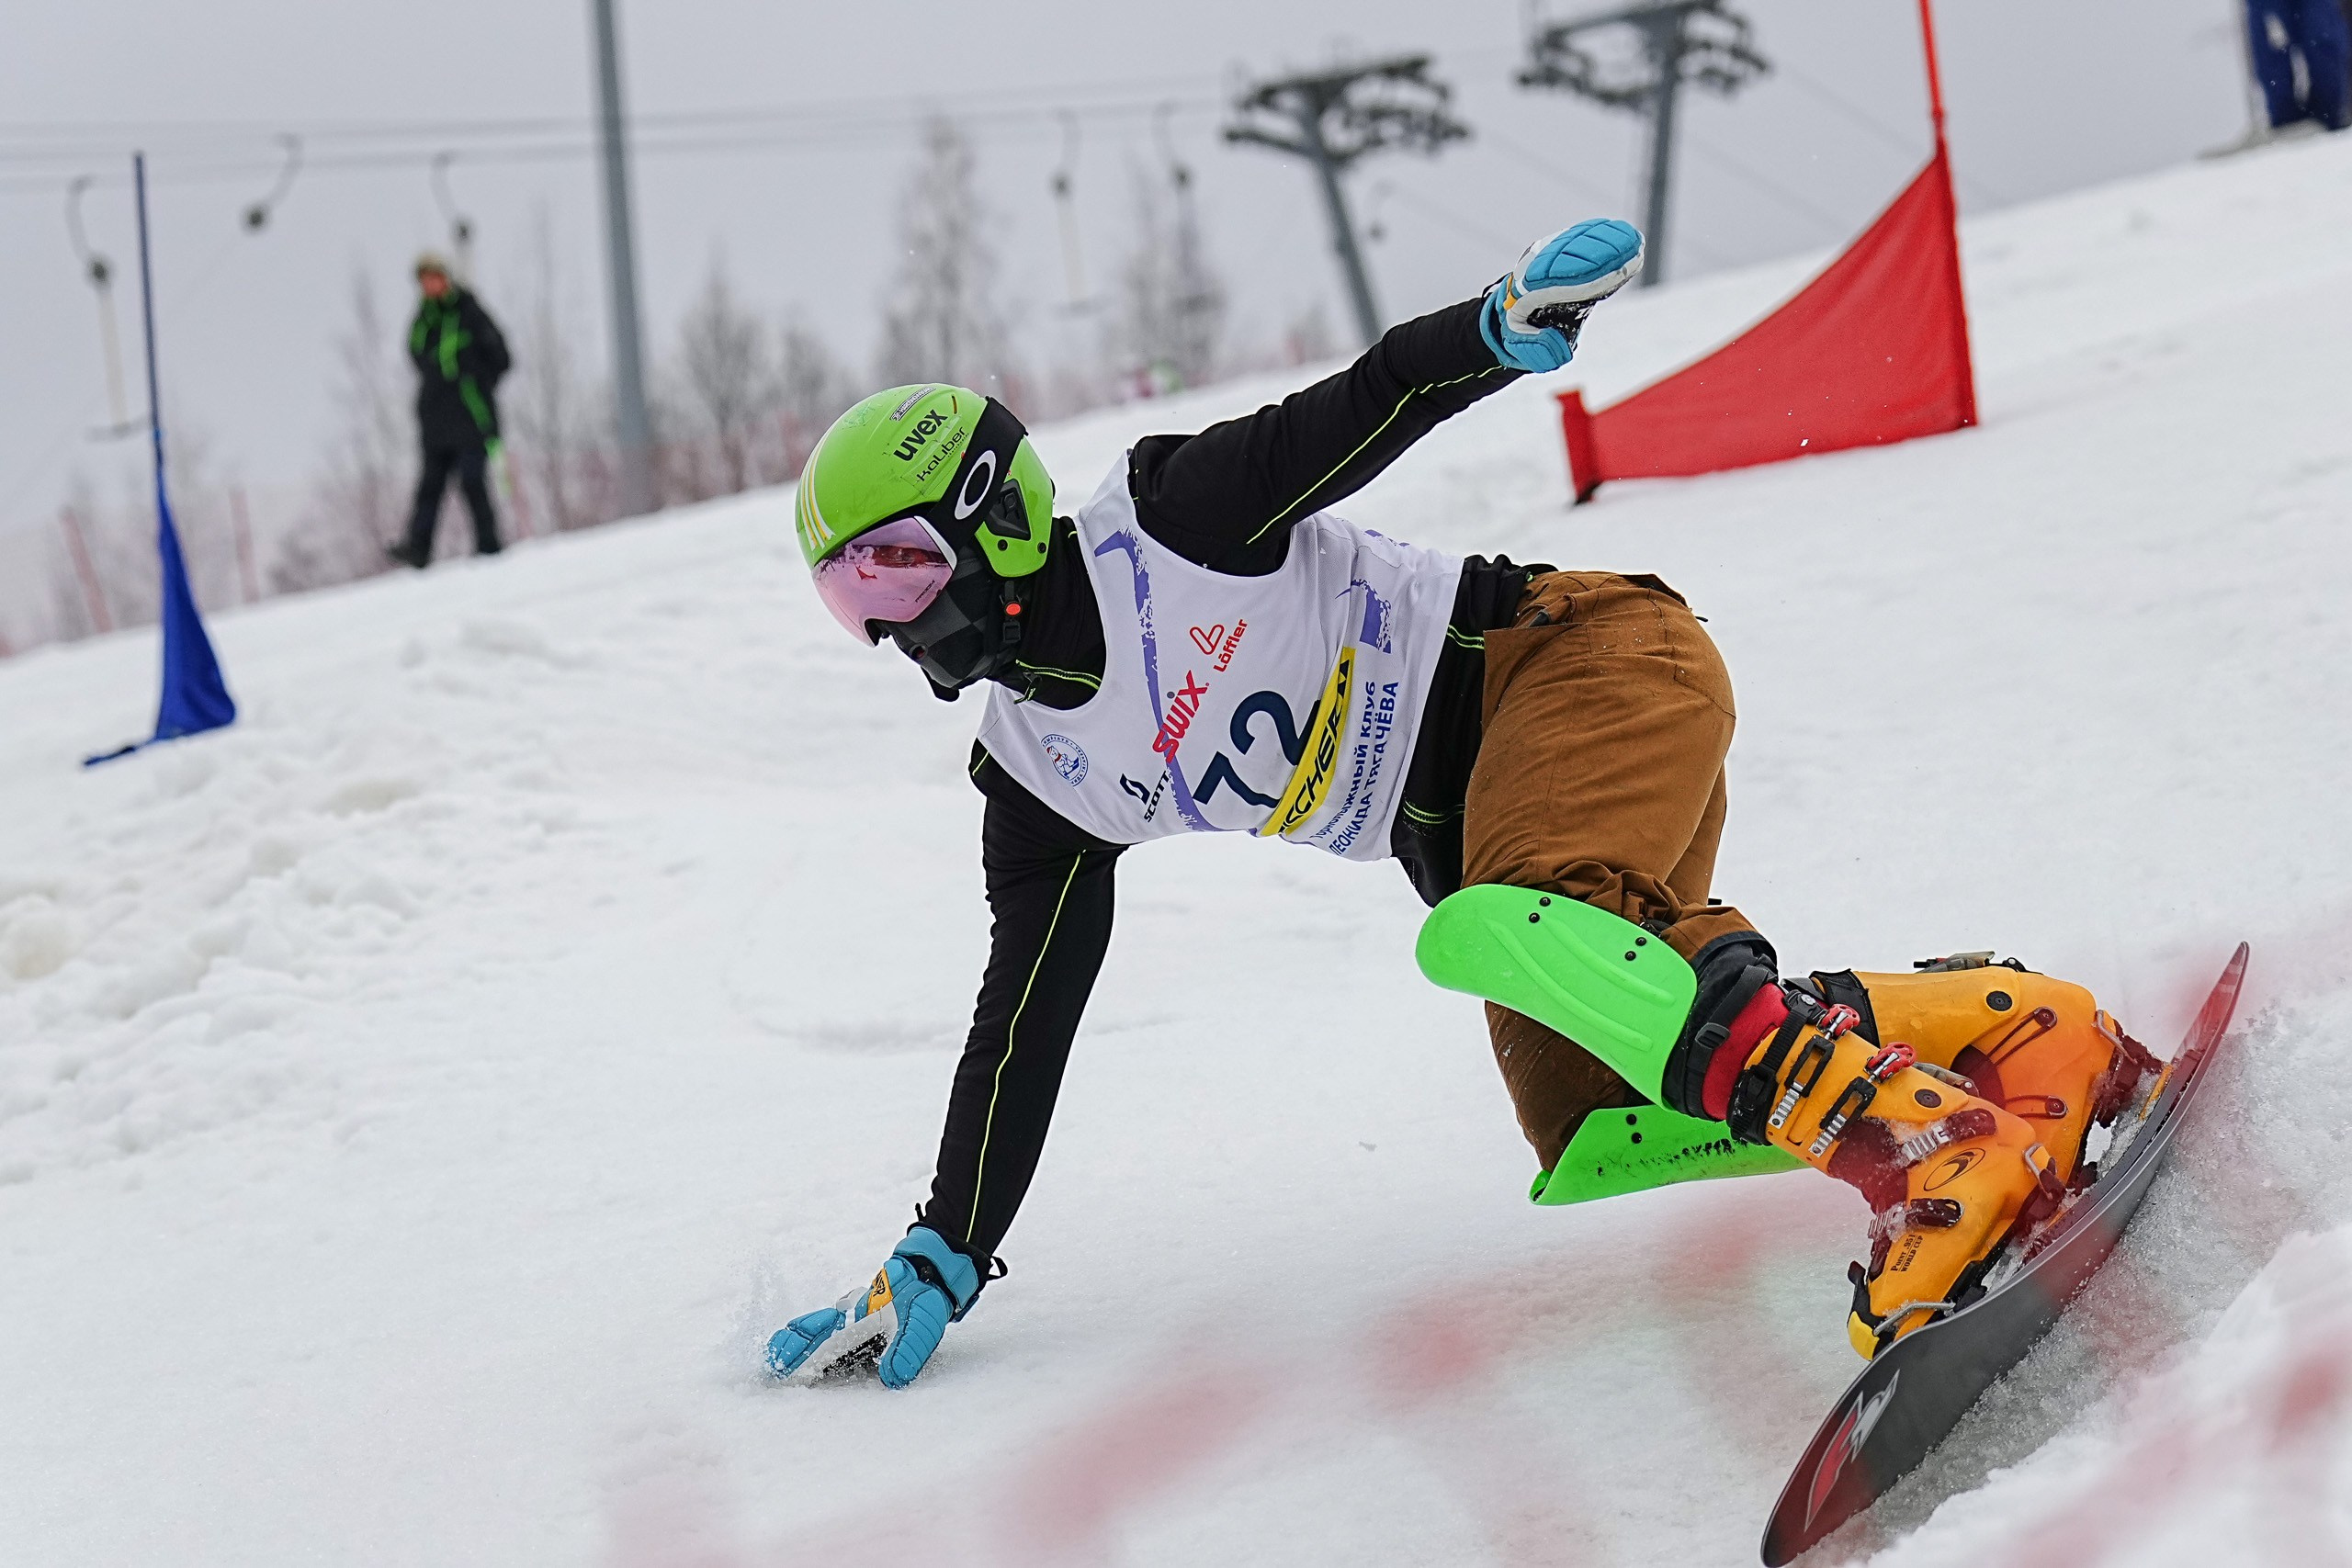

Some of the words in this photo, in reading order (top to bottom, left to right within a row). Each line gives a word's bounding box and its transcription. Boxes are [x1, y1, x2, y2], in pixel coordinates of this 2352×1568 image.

[892, 409, 948, 461] uvex
[1192, 690, 1321, 809] 72
[1363, 681, 1399, 791] ТЯГАЧЁВА
[1143, 769, 1170, 823] SCOTT
[1900, 1249, 1917, 1272] WORLD
[1913, 1235, 1924, 1249] CUP
